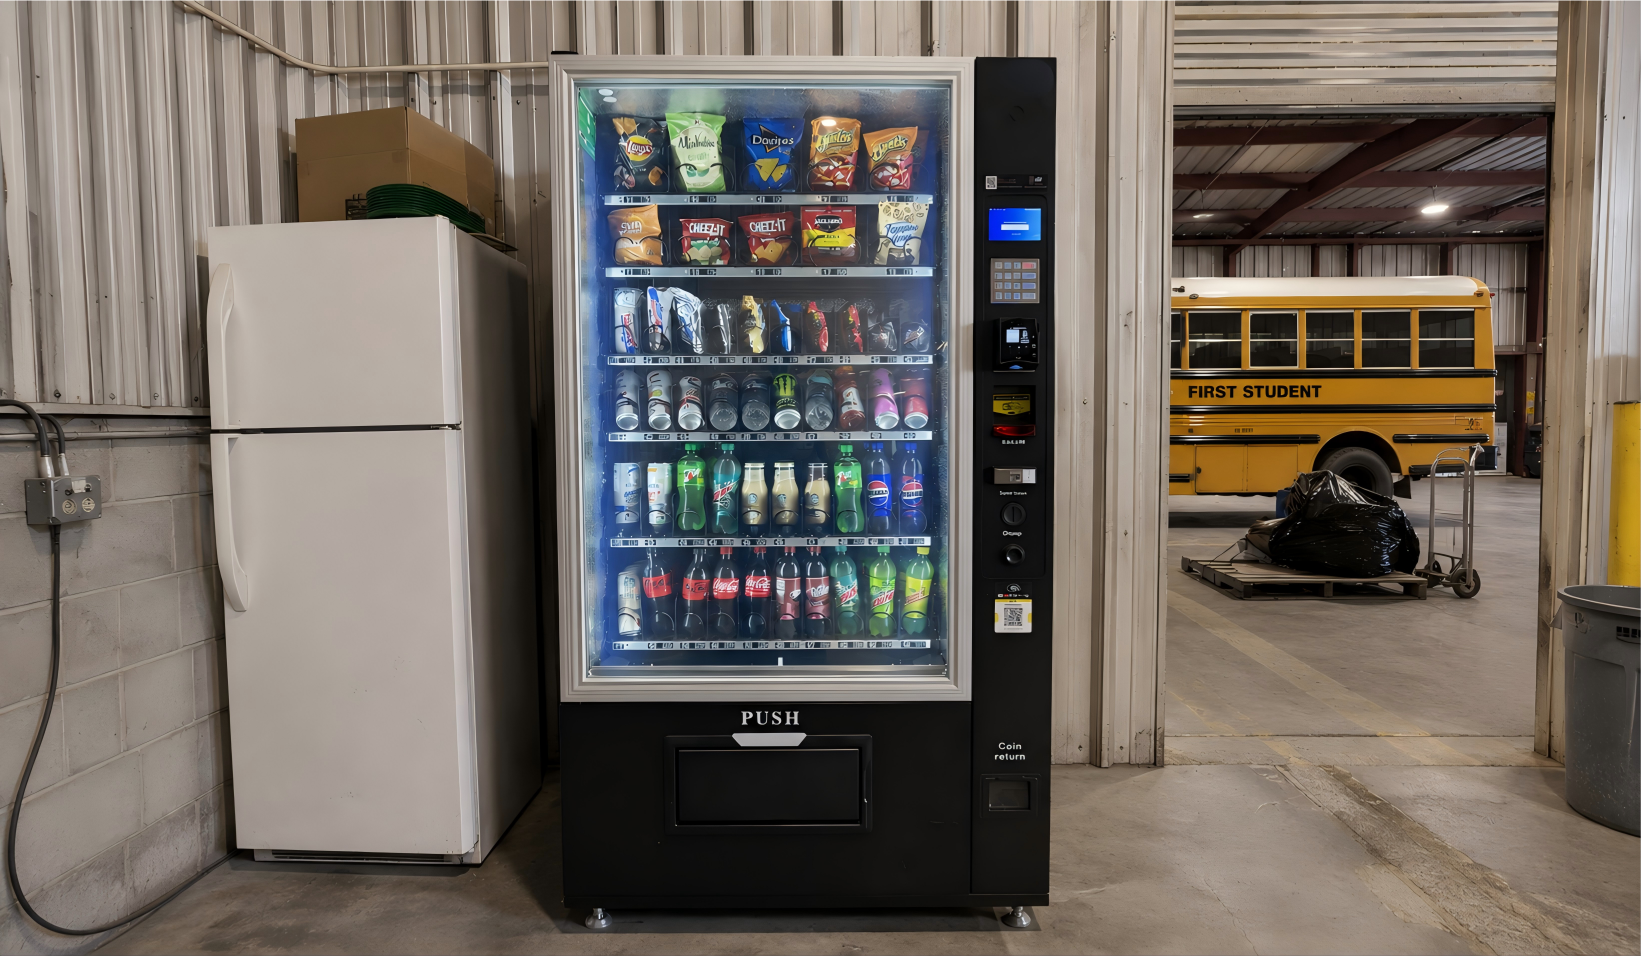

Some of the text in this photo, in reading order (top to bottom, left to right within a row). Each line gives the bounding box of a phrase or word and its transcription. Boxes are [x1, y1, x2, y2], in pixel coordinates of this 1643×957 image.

[1188, 385, 1322, 398] FIRST STUDENT
[741, 711, 800, 726] PUSH
[998, 742, 1022, 750] Coin
[994, 753, 1026, 761] return
